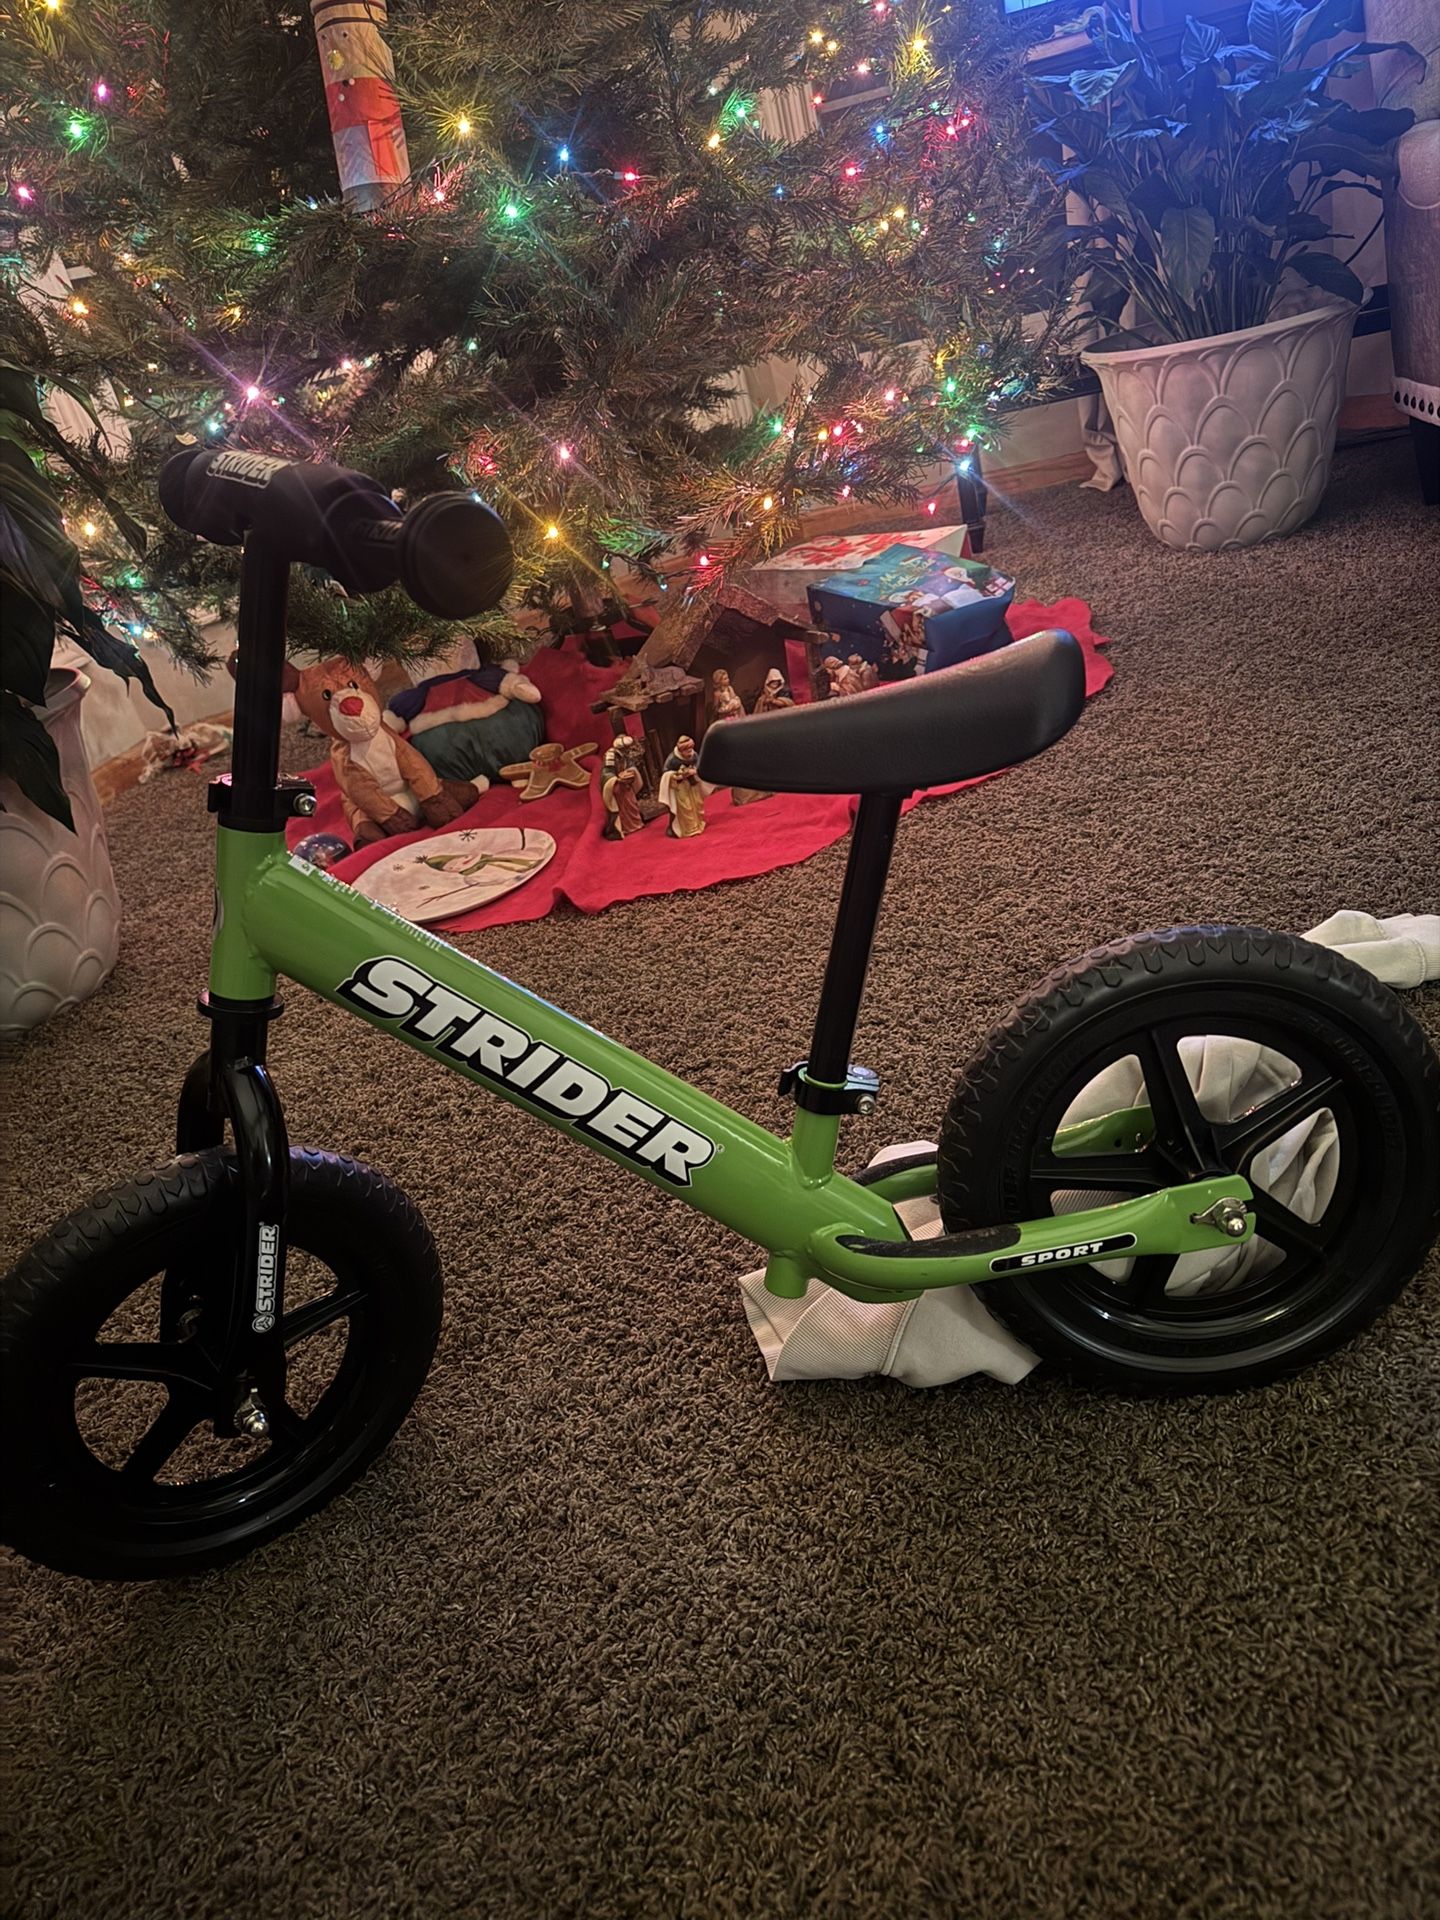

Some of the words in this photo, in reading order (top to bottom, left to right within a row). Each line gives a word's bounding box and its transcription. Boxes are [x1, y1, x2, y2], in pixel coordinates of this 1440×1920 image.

[209, 451, 288, 487] STRIDER
[343, 956, 715, 1185] STRIDER
[257, 1226, 279, 1312] STRIDER
[1021, 1242, 1103, 1266] SPORT
